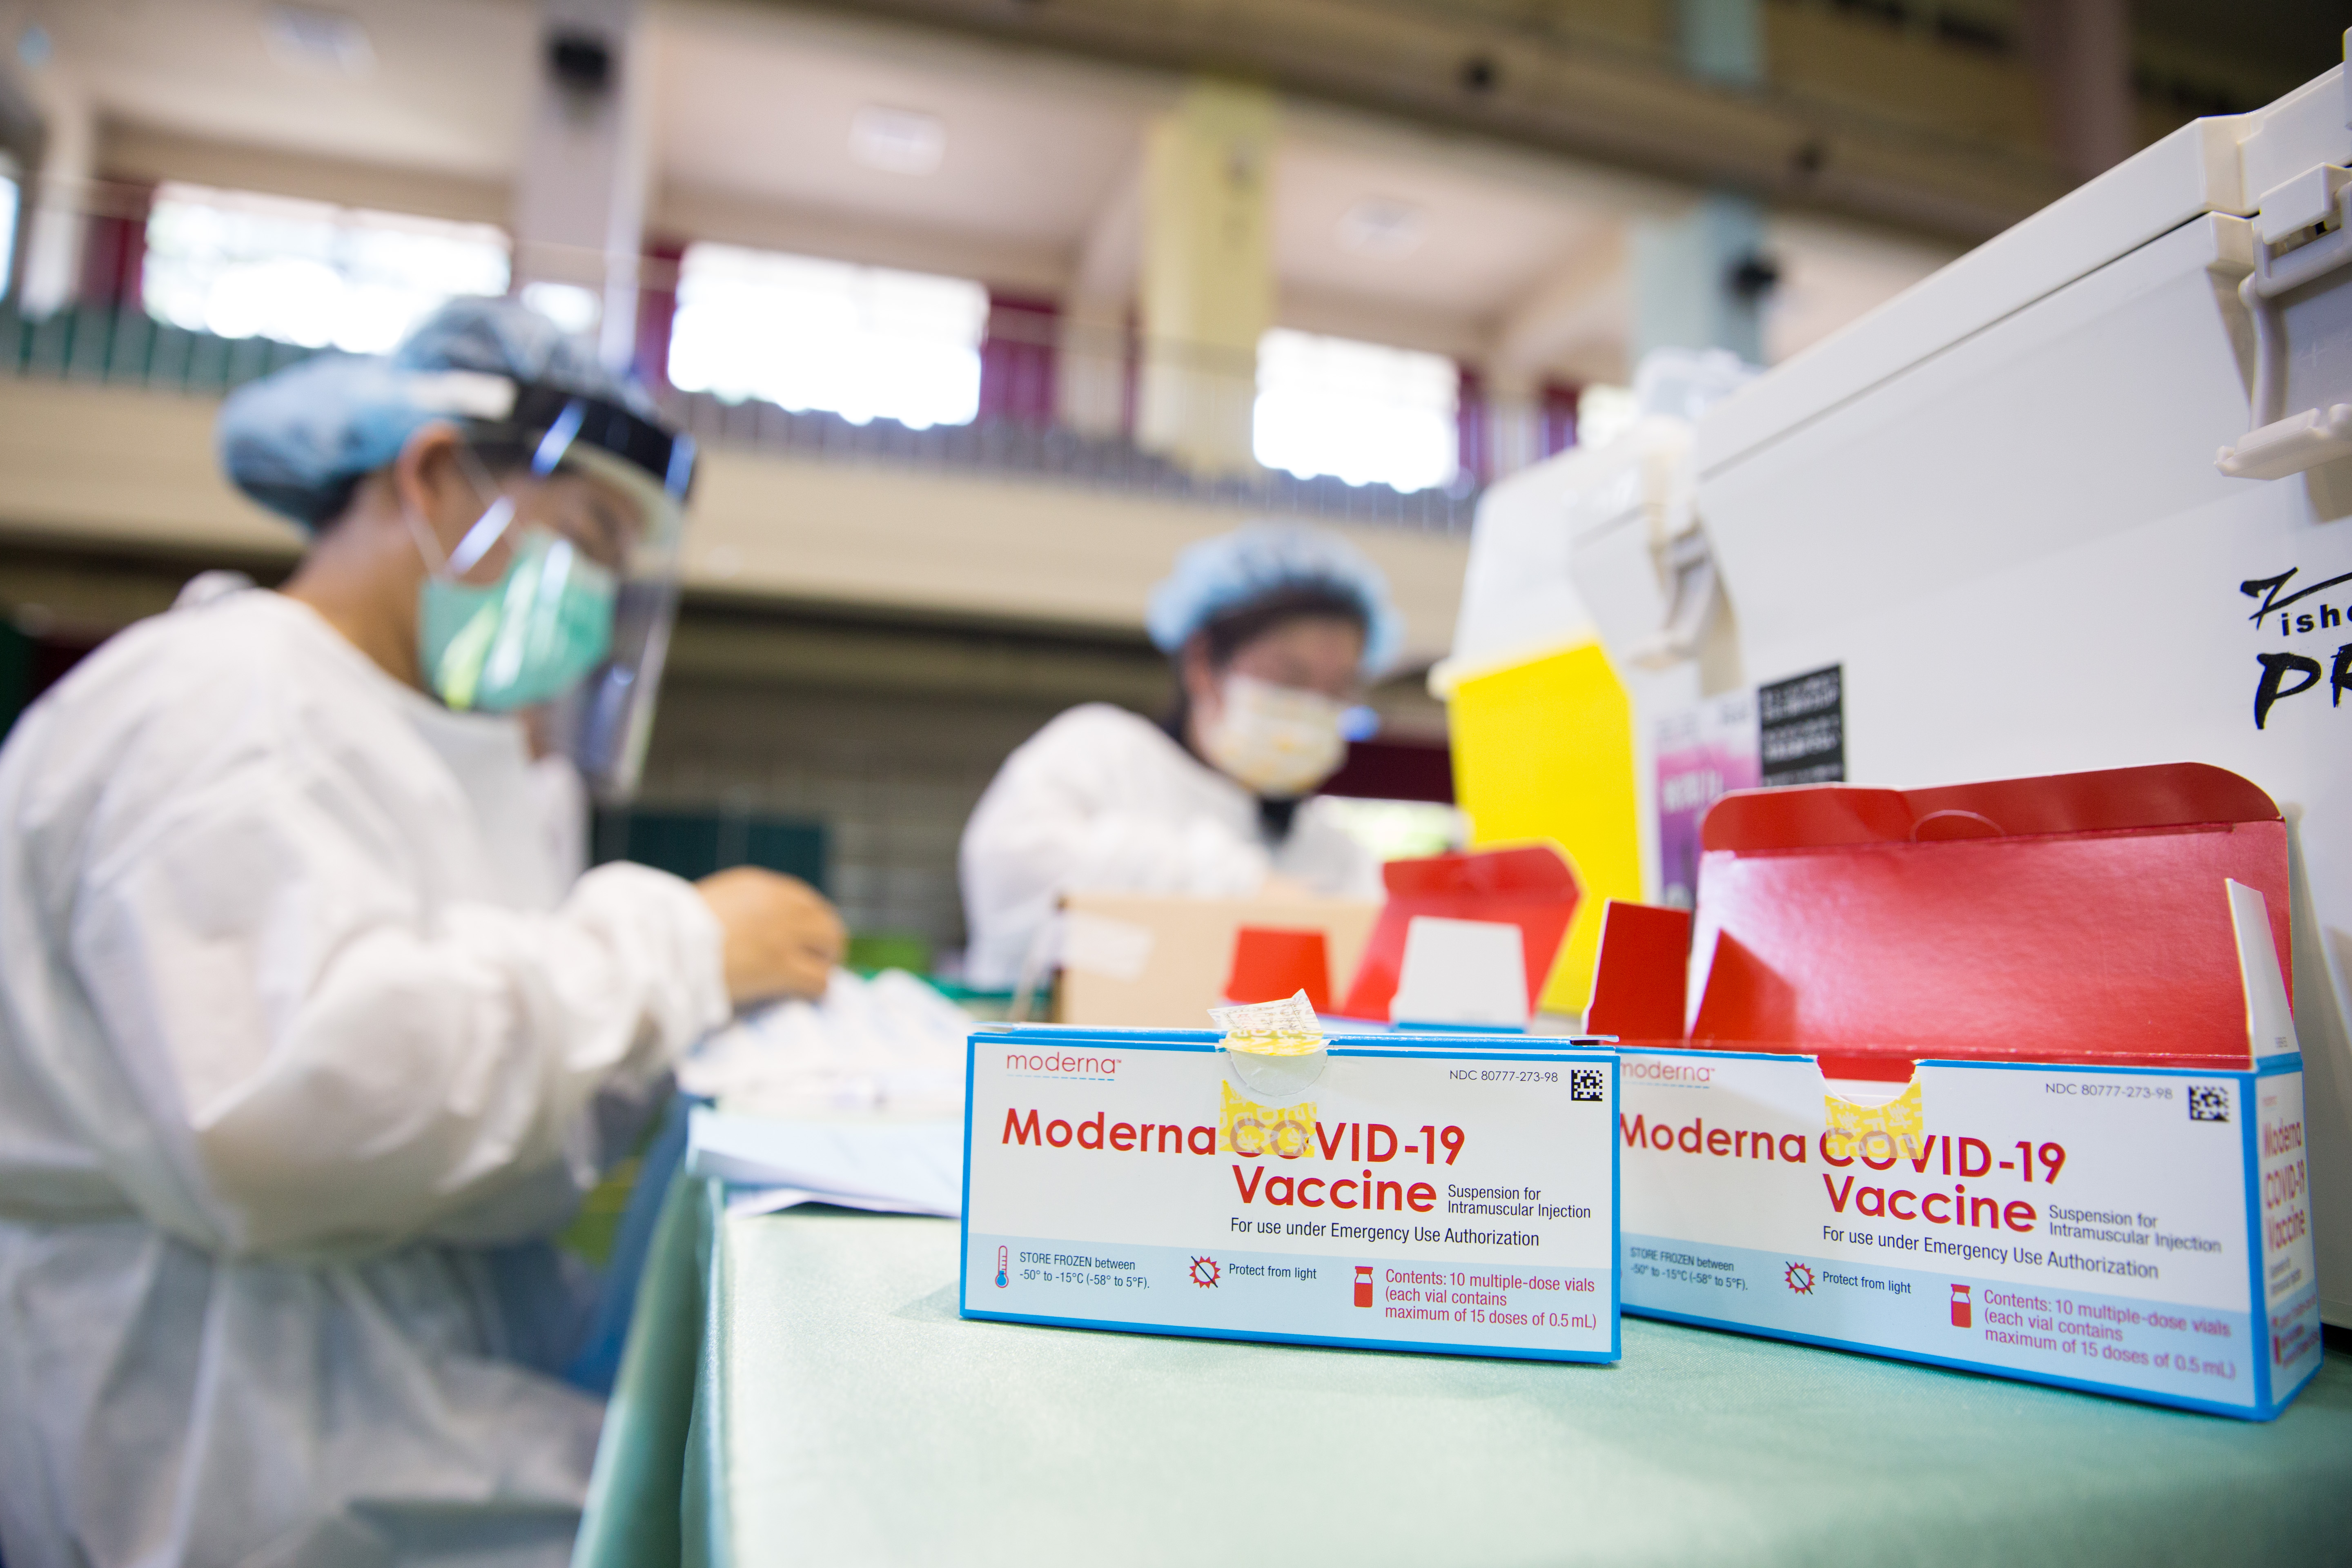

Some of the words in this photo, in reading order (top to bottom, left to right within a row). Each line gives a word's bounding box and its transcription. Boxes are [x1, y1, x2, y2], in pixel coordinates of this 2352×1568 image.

[2240, 567, 2352, 636] Fish
[1450, 1070, 1477, 1080] NDC
[1481, 1071, 1558, 1082] 80777-273-98
[2046, 1083, 2076, 1094] NDC
[2081, 1084, 2173, 1099] 80777-273-98
[1002, 1108, 1216, 1155] Moderna
[1230, 1118, 1465, 1166] COVID-19
[1620, 1113, 1806, 1163] Moderna
[1820, 1127, 2067, 1185] COVID-19
[1232, 1165, 1437, 1212] Vaccine
[1448, 1185, 1519, 1200] Suspension
[1524, 1187, 1541, 1200] for
[1449, 1200, 1534, 1216] Intramuscular
[1539, 1204, 1590, 1220] Injection
[1823, 1174, 2037, 1232] Vaccine
[2049, 1205, 2132, 1225] Suspension
[2137, 1213, 2156, 1228] for
[1232, 1218, 1252, 1232] For
[1258, 1223, 1281, 1234] use
[1287, 1222, 1326, 1236] under
[1332, 1223, 1409, 1243] Emergency
[1415, 1227, 1440, 1242] Use
[1445, 1228, 1539, 1246] Authorization
[2050, 1222, 2149, 1244] Intramuscular
[2155, 1233, 2221, 1252] Injection
[1020, 1252, 1051, 1264] STORE
[1054, 1254, 1091, 1267] FROZEN
[1095, 1258, 1135, 1270] between
[1630, 1247, 1657, 1261] STORE
[1660, 1252, 1694, 1266] FROZEN
[1697, 1257, 1734, 1271] between
[1824, 1226, 1844, 1241] For
[1849, 1232, 1873, 1245] use
[1879, 1235, 1919, 1250] under
[1924, 1237, 2007, 1264] Emergency
[2014, 1247, 2042, 1265] Use
[2047, 1251, 2158, 1278] Authorization
[1020, 1270, 1040, 1280] -50°
[1044, 1271, 1052, 1281] to
[1056, 1272, 1083, 1283] -15°C
[1087, 1273, 1111, 1285] (-58°
[1114, 1276, 1123, 1286] to
[1127, 1277, 1149, 1289] 5°F).
[1229, 1263, 1264, 1276] Protect
[1268, 1266, 1290, 1277] from
[1295, 1267, 1316, 1281] light
[1386, 1269, 1446, 1285] Contents:
[1450, 1273, 1465, 1286] 10
[1470, 1274, 1559, 1291] multiple-dose
[1565, 1278, 1594, 1292] vials
[1651, 1267, 1660, 1277] to
[1715, 1276, 1723, 1286] to
[1823, 1271, 1858, 1286] Protect
[1861, 1276, 1884, 1290] from
[1889, 1281, 1911, 1294] light
[1386, 1286, 1420, 1301] (each
[1425, 1290, 1446, 1303] vial
[1452, 1292, 1506, 1306] contains
[1386, 1306, 1449, 1321] maximum
[1454, 1309, 1466, 1321] of
[1471, 1310, 1484, 1323] 15
[1489, 1310, 1527, 1325] doses
[1532, 1312, 1544, 1325] of
[1550, 1313, 1568, 1327] 0.5
[1572, 1314, 1596, 1330] mL)
[1984, 1290, 2052, 1312] Contents:
[2056, 1300, 2072, 1314] 10
[2077, 1301, 2187, 1332] multiple-dose
[2194, 1322, 2231, 1339] vials
[1985, 1308, 2022, 1326] (each
[2029, 1318, 2052, 1330] vial
[2058, 1322, 2122, 1340] contains
[1986, 1330, 2056, 1350] maximum
[2062, 1340, 2075, 1352] of
[2082, 1342, 2097, 1356] 15
[2103, 1346, 2148, 1363] doses
[2154, 1353, 2170, 1369] of
[2174, 1355, 2200, 1374] 0.5
